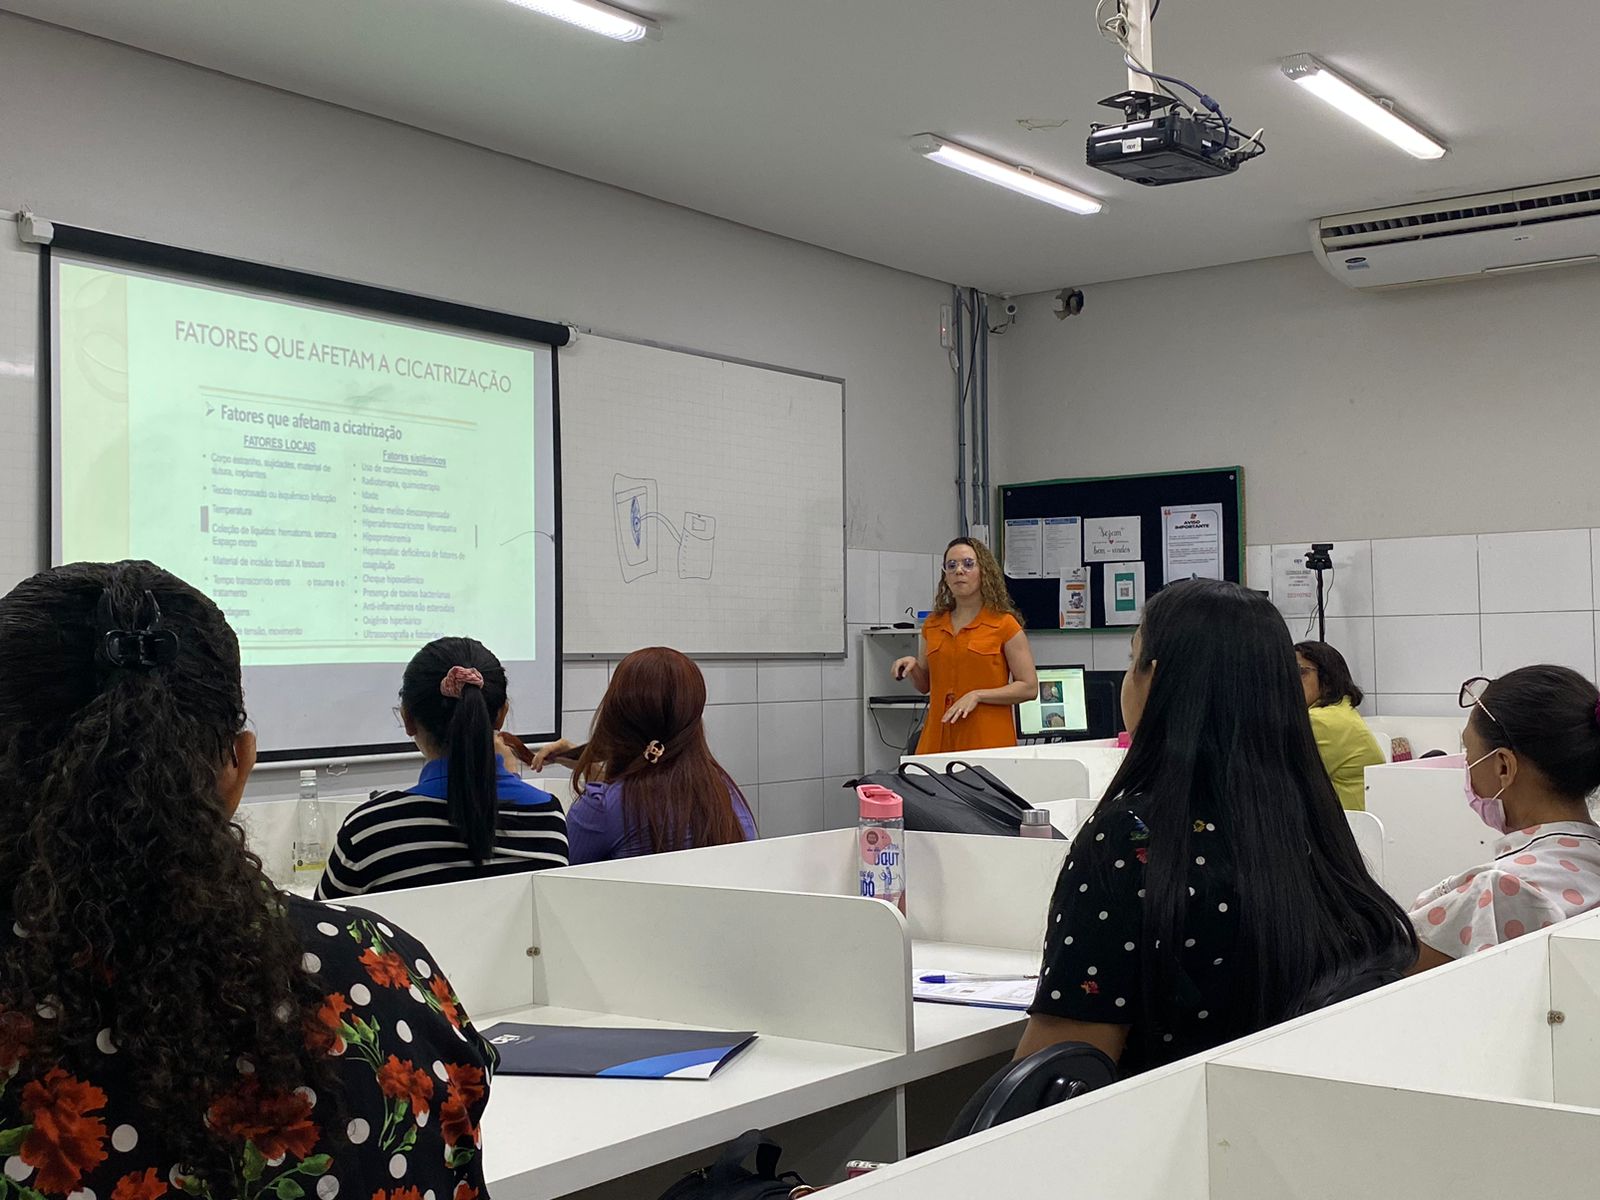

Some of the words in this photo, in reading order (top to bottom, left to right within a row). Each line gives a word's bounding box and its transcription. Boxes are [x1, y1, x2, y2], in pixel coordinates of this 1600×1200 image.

[175, 321, 258, 352] FATORES
[265, 335, 304, 360] QUE
[308, 343, 374, 370] AFETAM
[378, 354, 390, 373] A
[395, 358, 511, 392] CICATRIZAÇÃO
[221, 405, 264, 424] Fatores
[267, 414, 289, 429] que
[292, 413, 331, 431] afetam
[333, 422, 340, 433] a
[343, 420, 402, 441] cicatrização
[244, 435, 283, 449] FATORES
[285, 439, 316, 452] LOCAIS
[383, 450, 409, 462] Fatores
[410, 454, 446, 466] sistêmicos
[323, 464, 331, 472] de
[374, 464, 382, 473] de
[268, 491, 277, 499] ou
[212, 504, 252, 516] Temperatura
[239, 526, 249, 535] de
[432, 549, 439, 559] de
[240, 558, 249, 566] de
[295, 559, 301, 568] X
[213, 574, 235, 585] Tempo
[389, 588, 398, 598] de
